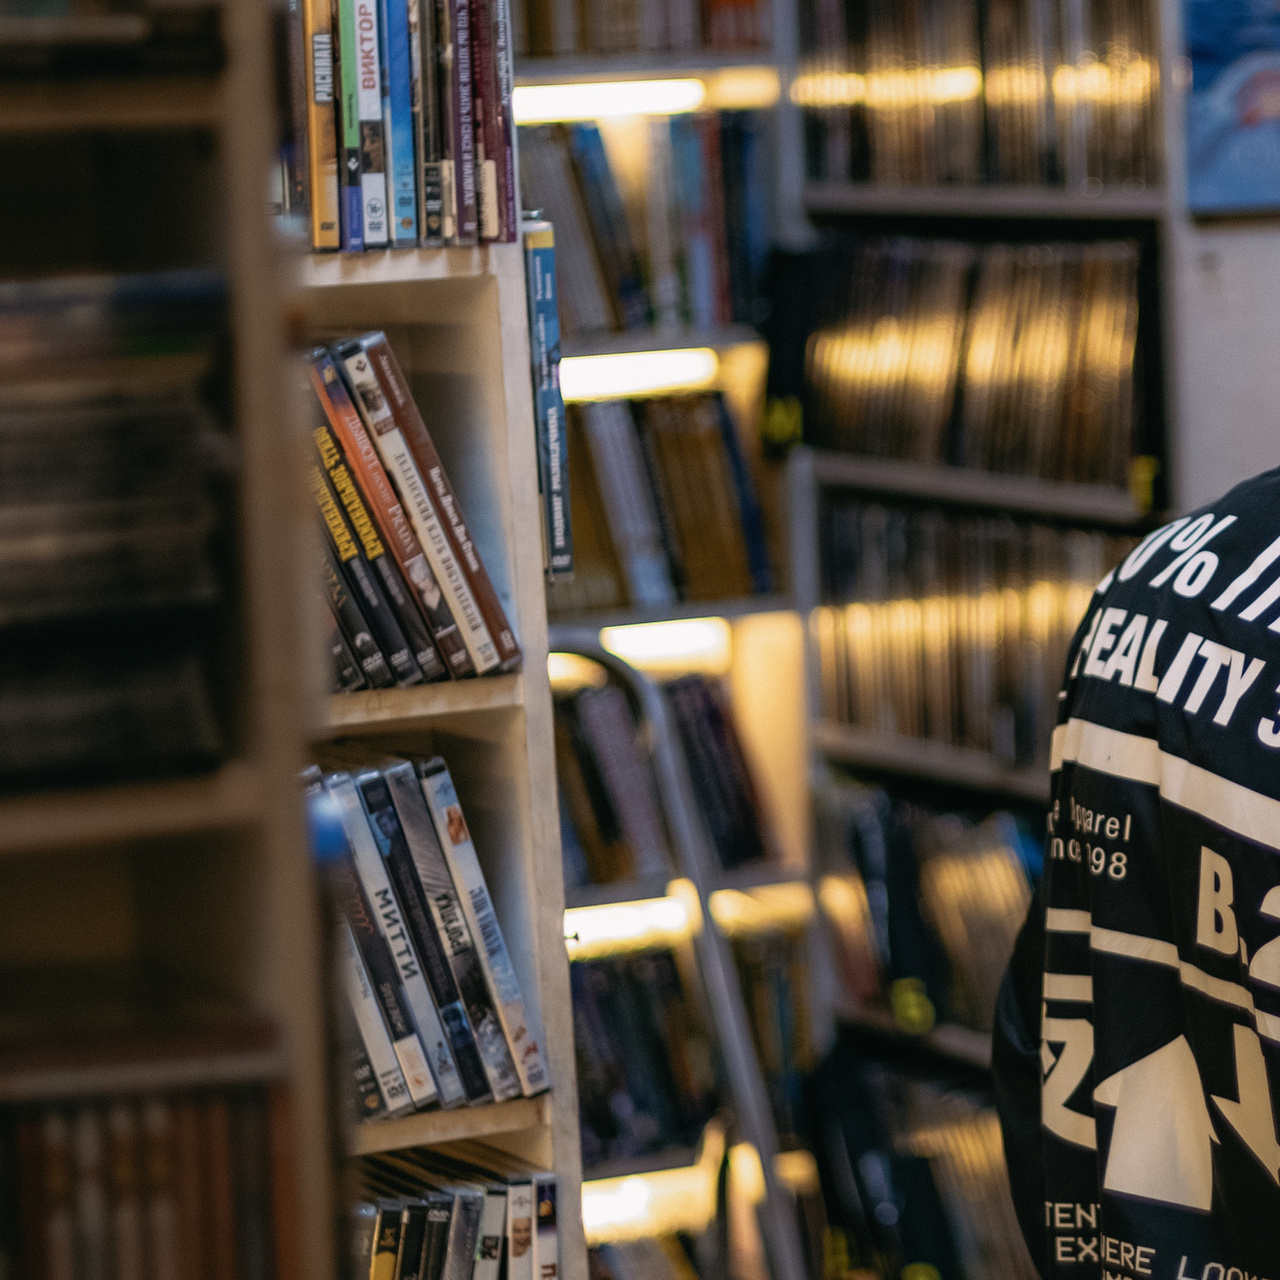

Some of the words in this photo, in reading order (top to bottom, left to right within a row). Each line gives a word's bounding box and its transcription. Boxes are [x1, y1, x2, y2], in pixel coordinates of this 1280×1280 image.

[312, 33, 332, 102] РАСПЛАТА
[357, 4, 377, 91] ВИКТОР
[332, 462, 385, 561] КРИМИНАЛЬНОЕ
[386, 503, 416, 555] PRADA
[1096, 513, 1238, 599] 0%
[375, 888, 419, 980] МИТТИ
[434, 893, 469, 957] ПРОГУЛКА
[1101, 1233, 1156, 1275] ERE
